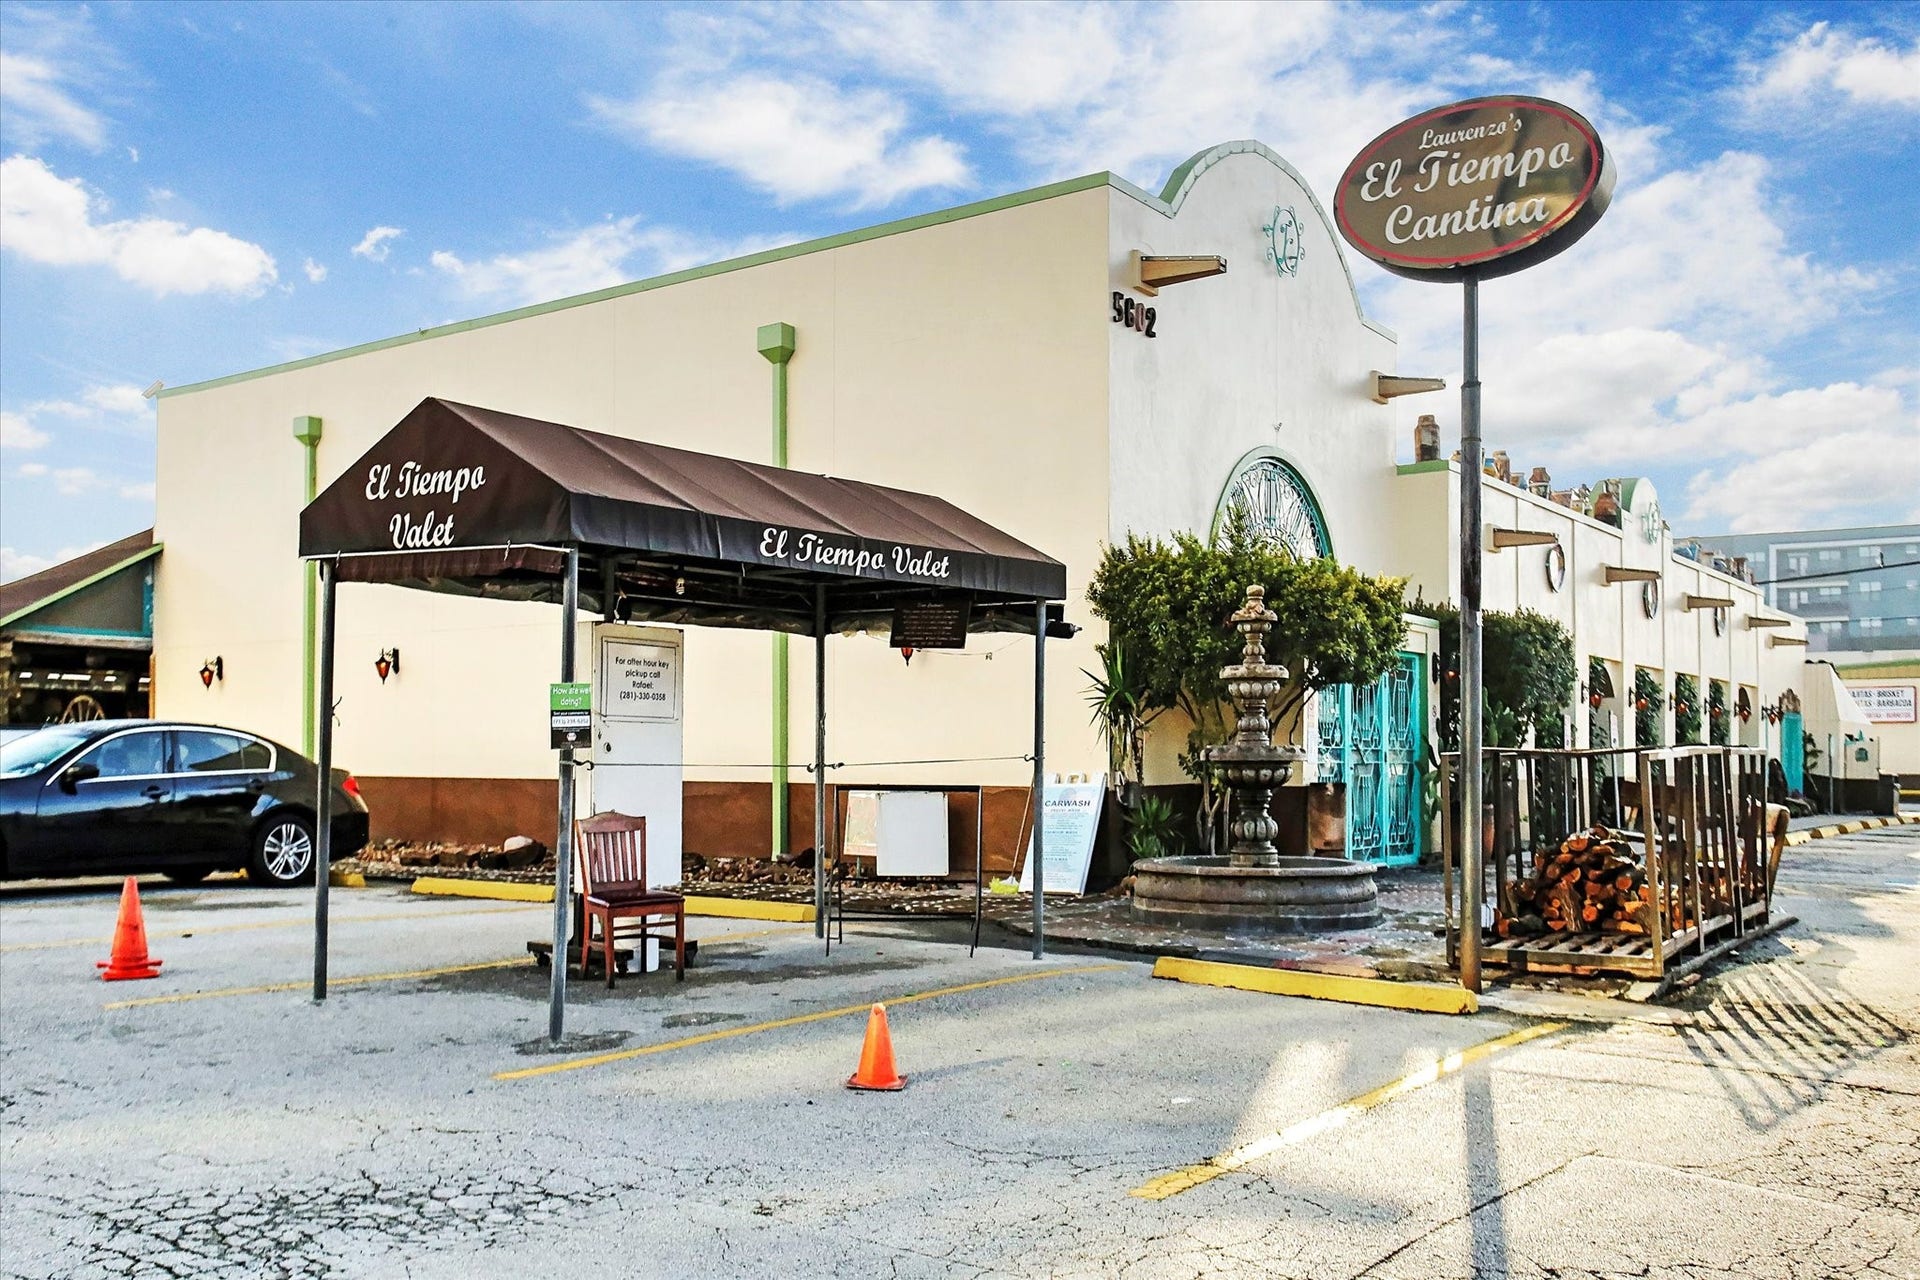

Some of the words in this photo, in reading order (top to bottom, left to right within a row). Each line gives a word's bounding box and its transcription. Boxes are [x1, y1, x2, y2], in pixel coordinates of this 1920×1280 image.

[1418, 113, 1522, 150] Laurenzo's
[1360, 158, 1402, 202] El
[1413, 142, 1574, 193] Tiempo
[1385, 195, 1549, 244] Cantina
[1112, 291, 1156, 338] 5602
[365, 463, 391, 500] El
[395, 461, 486, 504] Tiempo
[389, 510, 455, 549] Valet
[760, 527, 788, 559] El
[795, 533, 886, 576] Tiempo
[891, 545, 950, 578] Valet
[615, 656, 626, 665] For
[627, 657, 642, 666] after
[643, 659, 657, 667] hour
[658, 659, 669, 670] key
[625, 669, 648, 679] pickup
[649, 671, 661, 679] call
[552, 687, 568, 695] How
[560, 697, 582, 707] doing?
